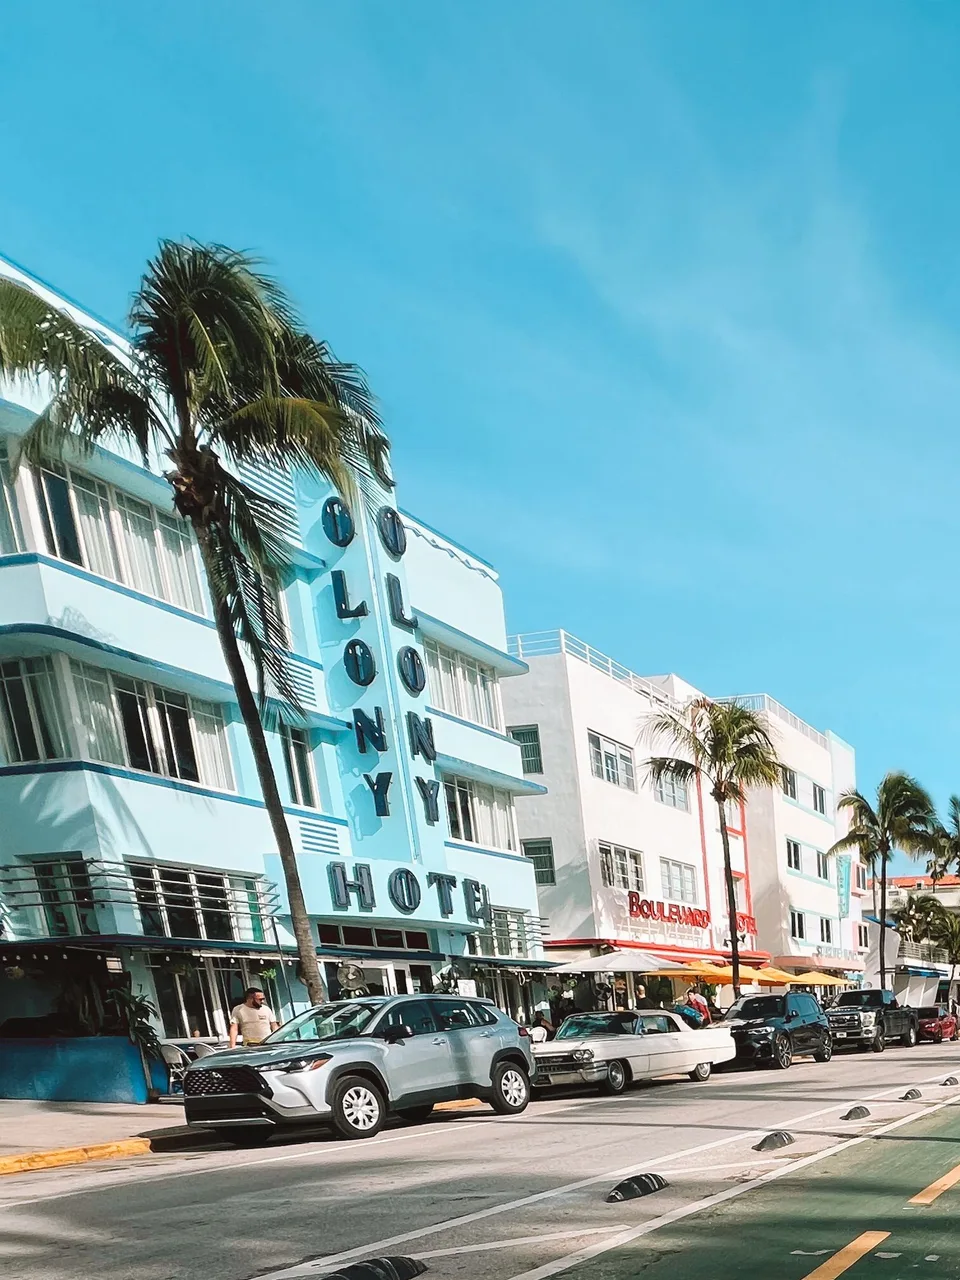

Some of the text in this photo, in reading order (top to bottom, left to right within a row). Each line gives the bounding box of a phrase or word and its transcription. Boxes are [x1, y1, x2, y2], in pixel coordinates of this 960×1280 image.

[321, 496, 392, 817] OLONY
[327, 860, 494, 925] HOTEL
[628, 890, 711, 929] BOULEVARD
[736, 911, 758, 936] OTEL
